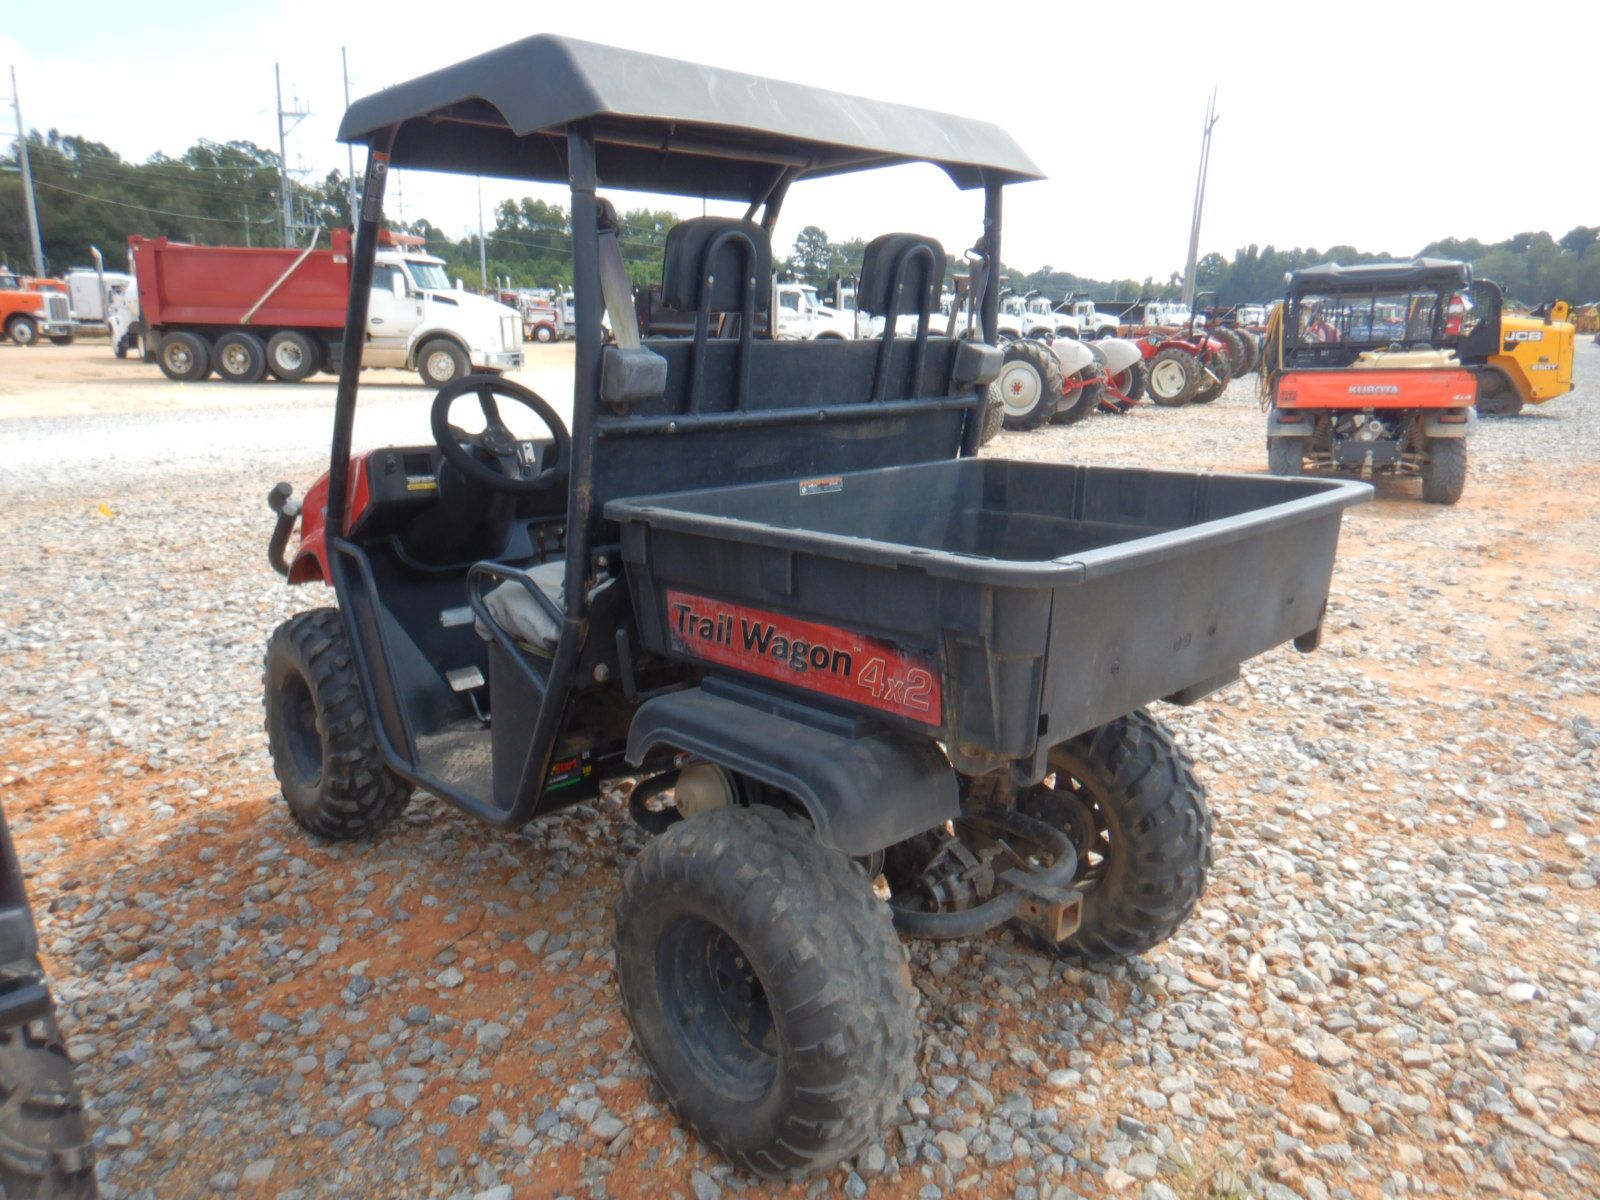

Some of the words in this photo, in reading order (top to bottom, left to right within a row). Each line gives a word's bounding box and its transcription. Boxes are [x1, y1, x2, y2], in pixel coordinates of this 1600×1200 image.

[1504, 331, 1542, 341] JCB
[1348, 385, 1400, 395] KUBOTA
[673, 602, 734, 646] Trail
[857, 656, 933, 712] 4x2
